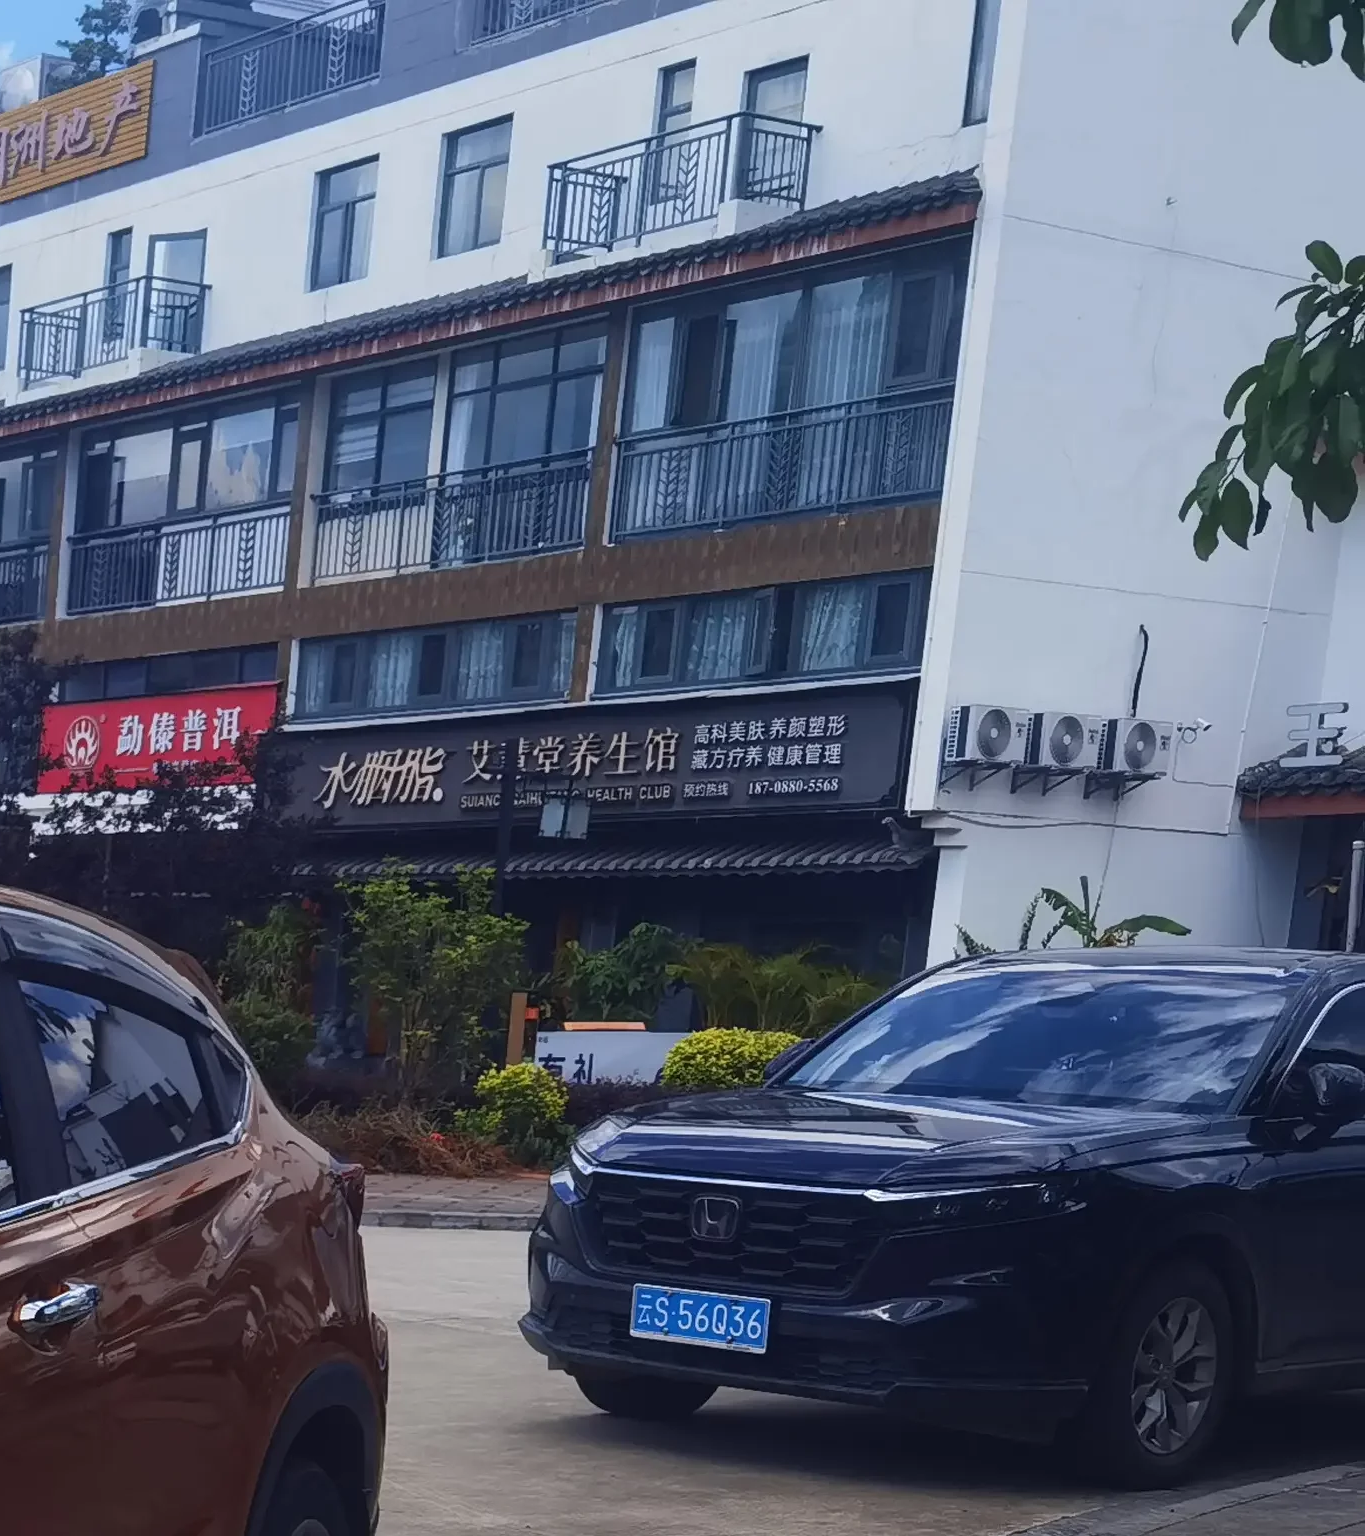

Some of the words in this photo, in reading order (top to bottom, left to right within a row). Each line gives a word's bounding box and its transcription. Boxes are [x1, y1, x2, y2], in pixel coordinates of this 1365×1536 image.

[115, 706, 242, 756] 勐傣普洱
[693, 720, 766, 745] 高科美肤
[769, 714, 846, 741] 养颜塑形
[690, 746, 763, 770] 藏方疗养
[767, 743, 842, 767] 健康管理
[639, 785, 672, 800] CLUB
[682, 782, 730, 798] 预约热线
[748, 778, 839, 795] 187-0880-5568
